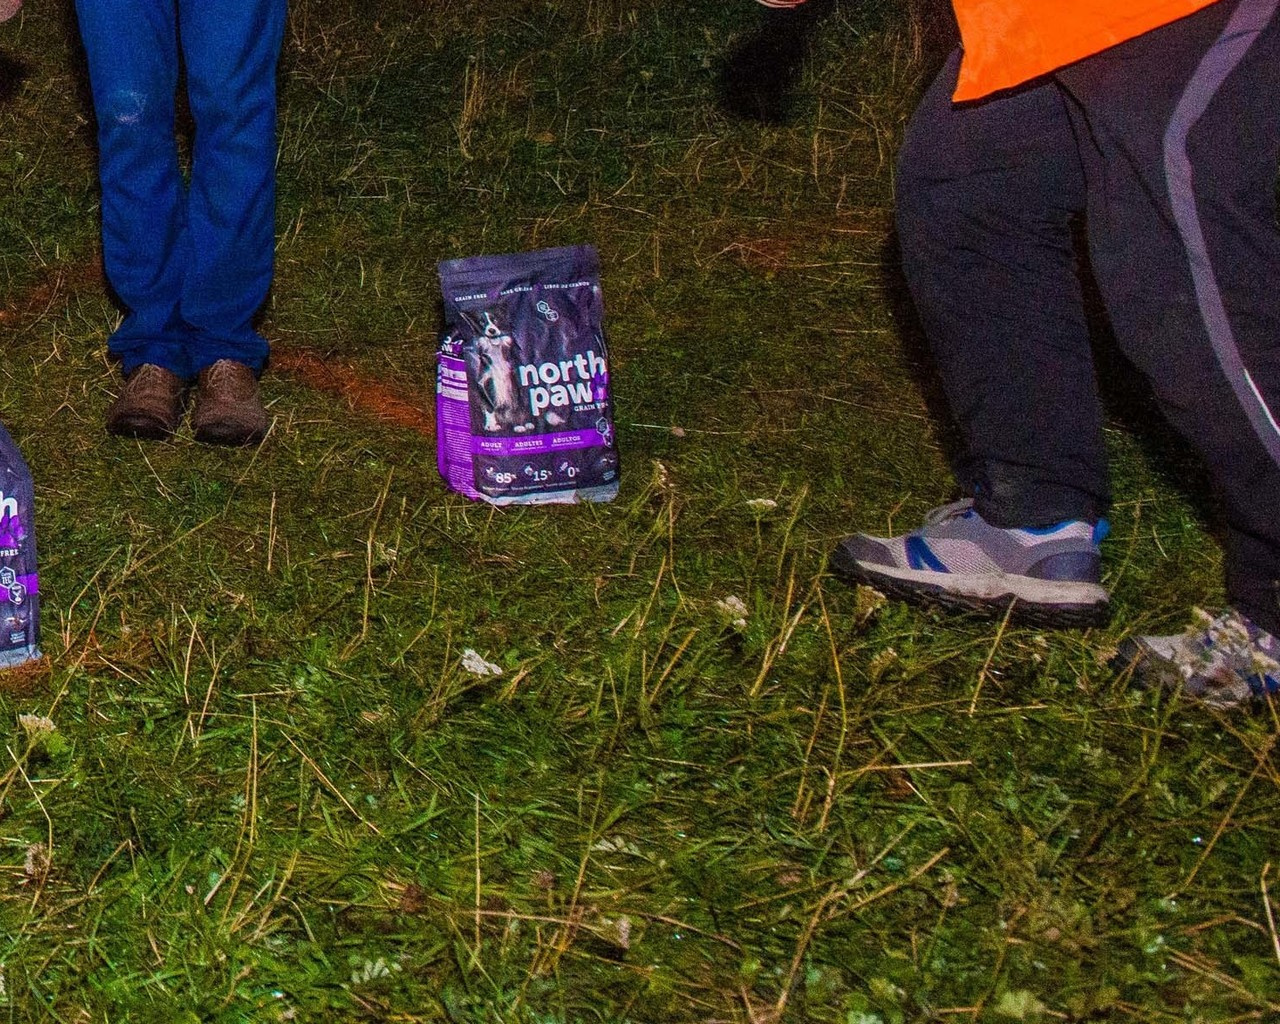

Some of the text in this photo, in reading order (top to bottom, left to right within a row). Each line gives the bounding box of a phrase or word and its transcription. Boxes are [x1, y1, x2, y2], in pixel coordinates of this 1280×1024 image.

[518, 350, 607, 387] north
[529, 381, 593, 416] paw
[0, 548, 19, 557] FREE
